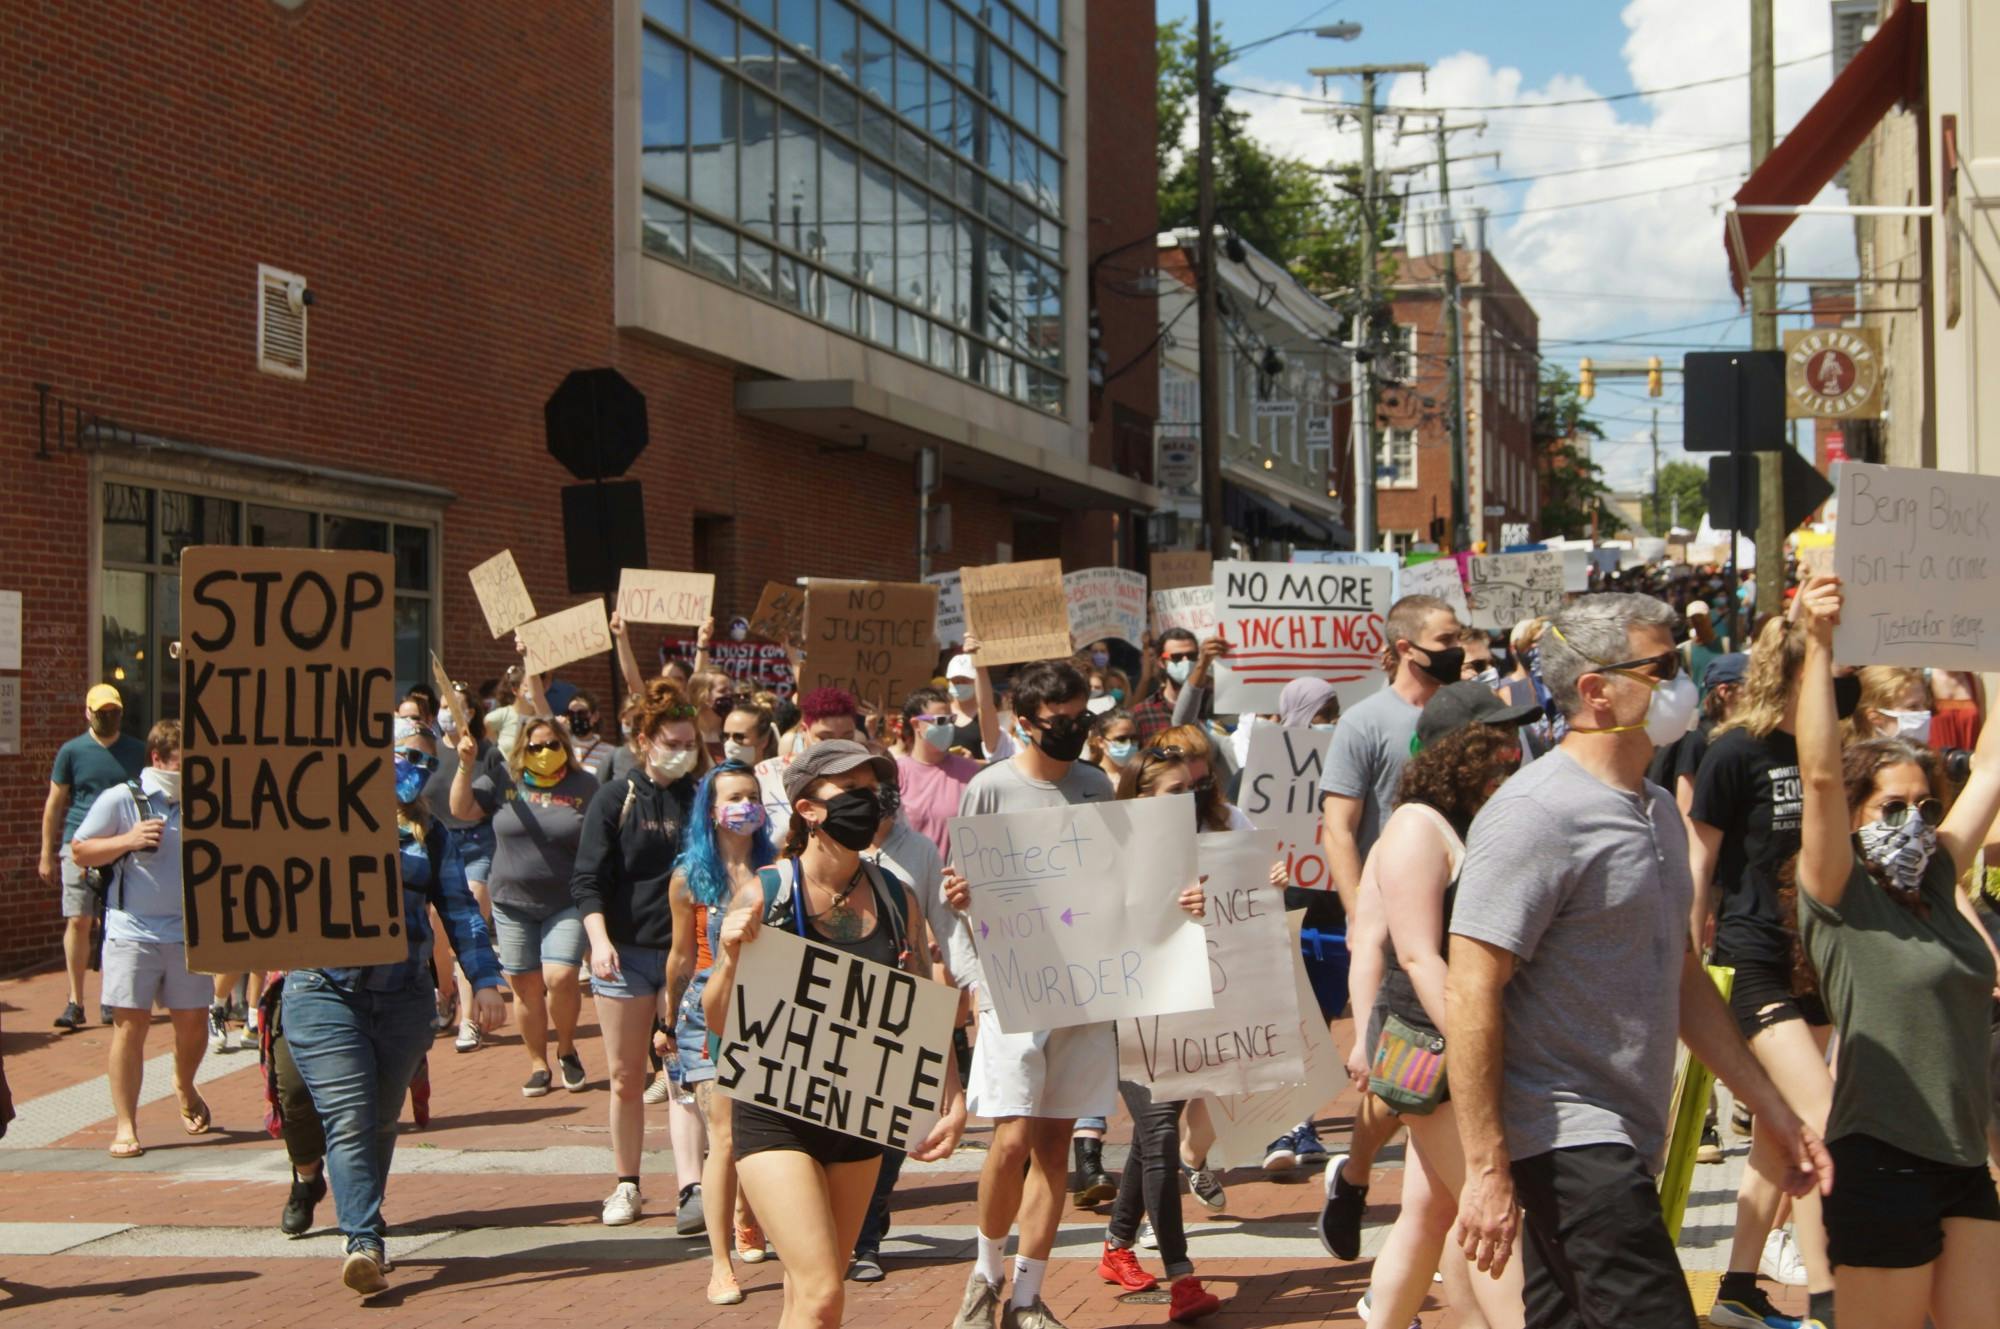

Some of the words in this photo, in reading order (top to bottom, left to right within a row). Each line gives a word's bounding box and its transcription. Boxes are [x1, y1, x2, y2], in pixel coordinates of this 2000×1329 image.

[1227, 572, 1267, 603] NO
[1279, 573, 1374, 606] MORE
[1919, 555, 1937, 581] a
[191, 569, 384, 652] STOP
[618, 589, 656, 619] NOT
[653, 597, 665, 613] A
[666, 592, 711, 622] CRIME
[848, 589, 885, 611] NO
[528, 621, 607, 671] NAMES
[822, 617, 928, 648] JUSTICE
[1218, 613, 1385, 652] LYNCHINGS
[857, 649, 892, 675] NO
[183, 660, 393, 750] KILLING
[183, 751, 383, 834] BLACK
[957, 822, 1093, 878] Protect
[183, 838, 400, 947] PEOPLE!
[1000, 906, 1050, 941] NOT
[794, 944, 917, 1037] END
[992, 948, 1145, 1018] MURDER
[737, 984, 944, 1111] WHITE
[1135, 1014, 1286, 1083] VIOLENCE
[717, 1041, 913, 1150] SILENCE
